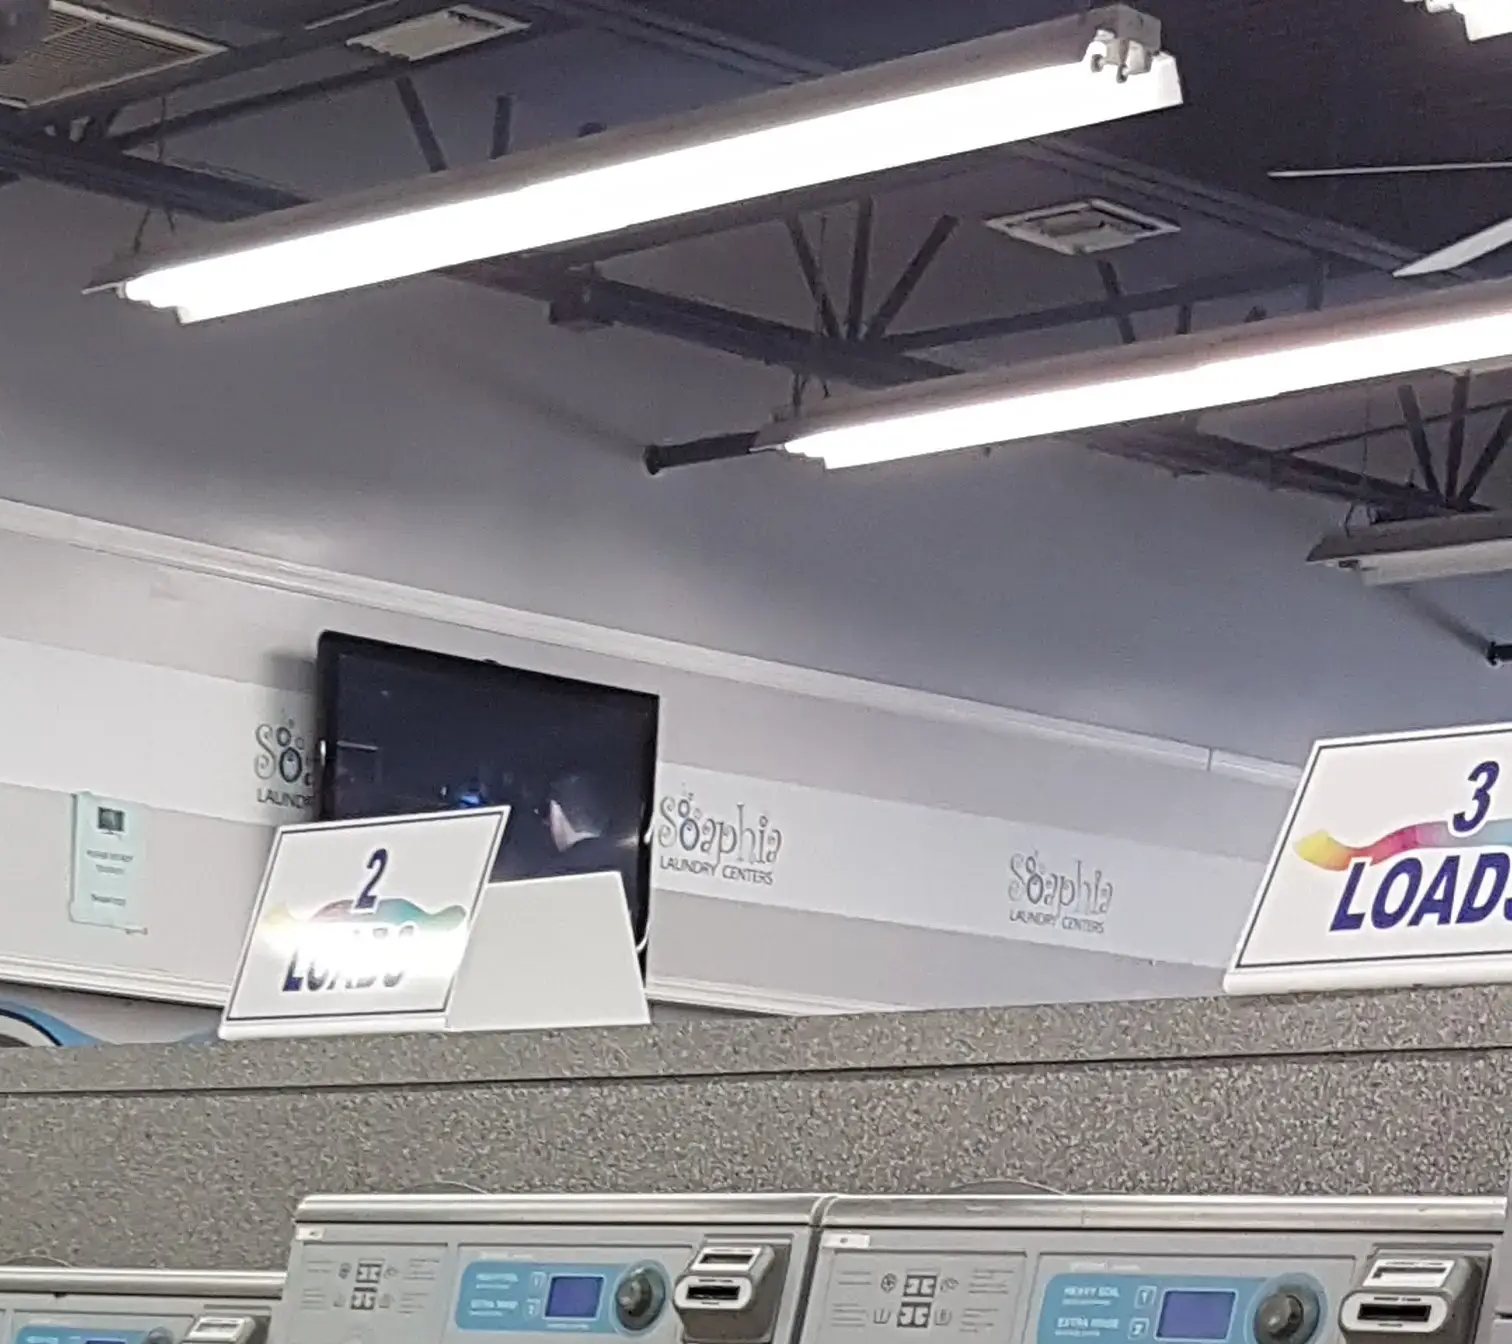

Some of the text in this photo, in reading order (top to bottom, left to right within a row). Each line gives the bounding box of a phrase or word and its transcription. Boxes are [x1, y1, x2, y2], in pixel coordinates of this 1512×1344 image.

[1452, 760, 1500, 833] 3
[658, 796, 783, 865] Soaphia
[355, 847, 388, 909] 2
[659, 855, 774, 886] LAUNDRY CENTERS
[1008, 852, 1114, 918] Soaphia
[1328, 851, 1512, 933] LOAD
